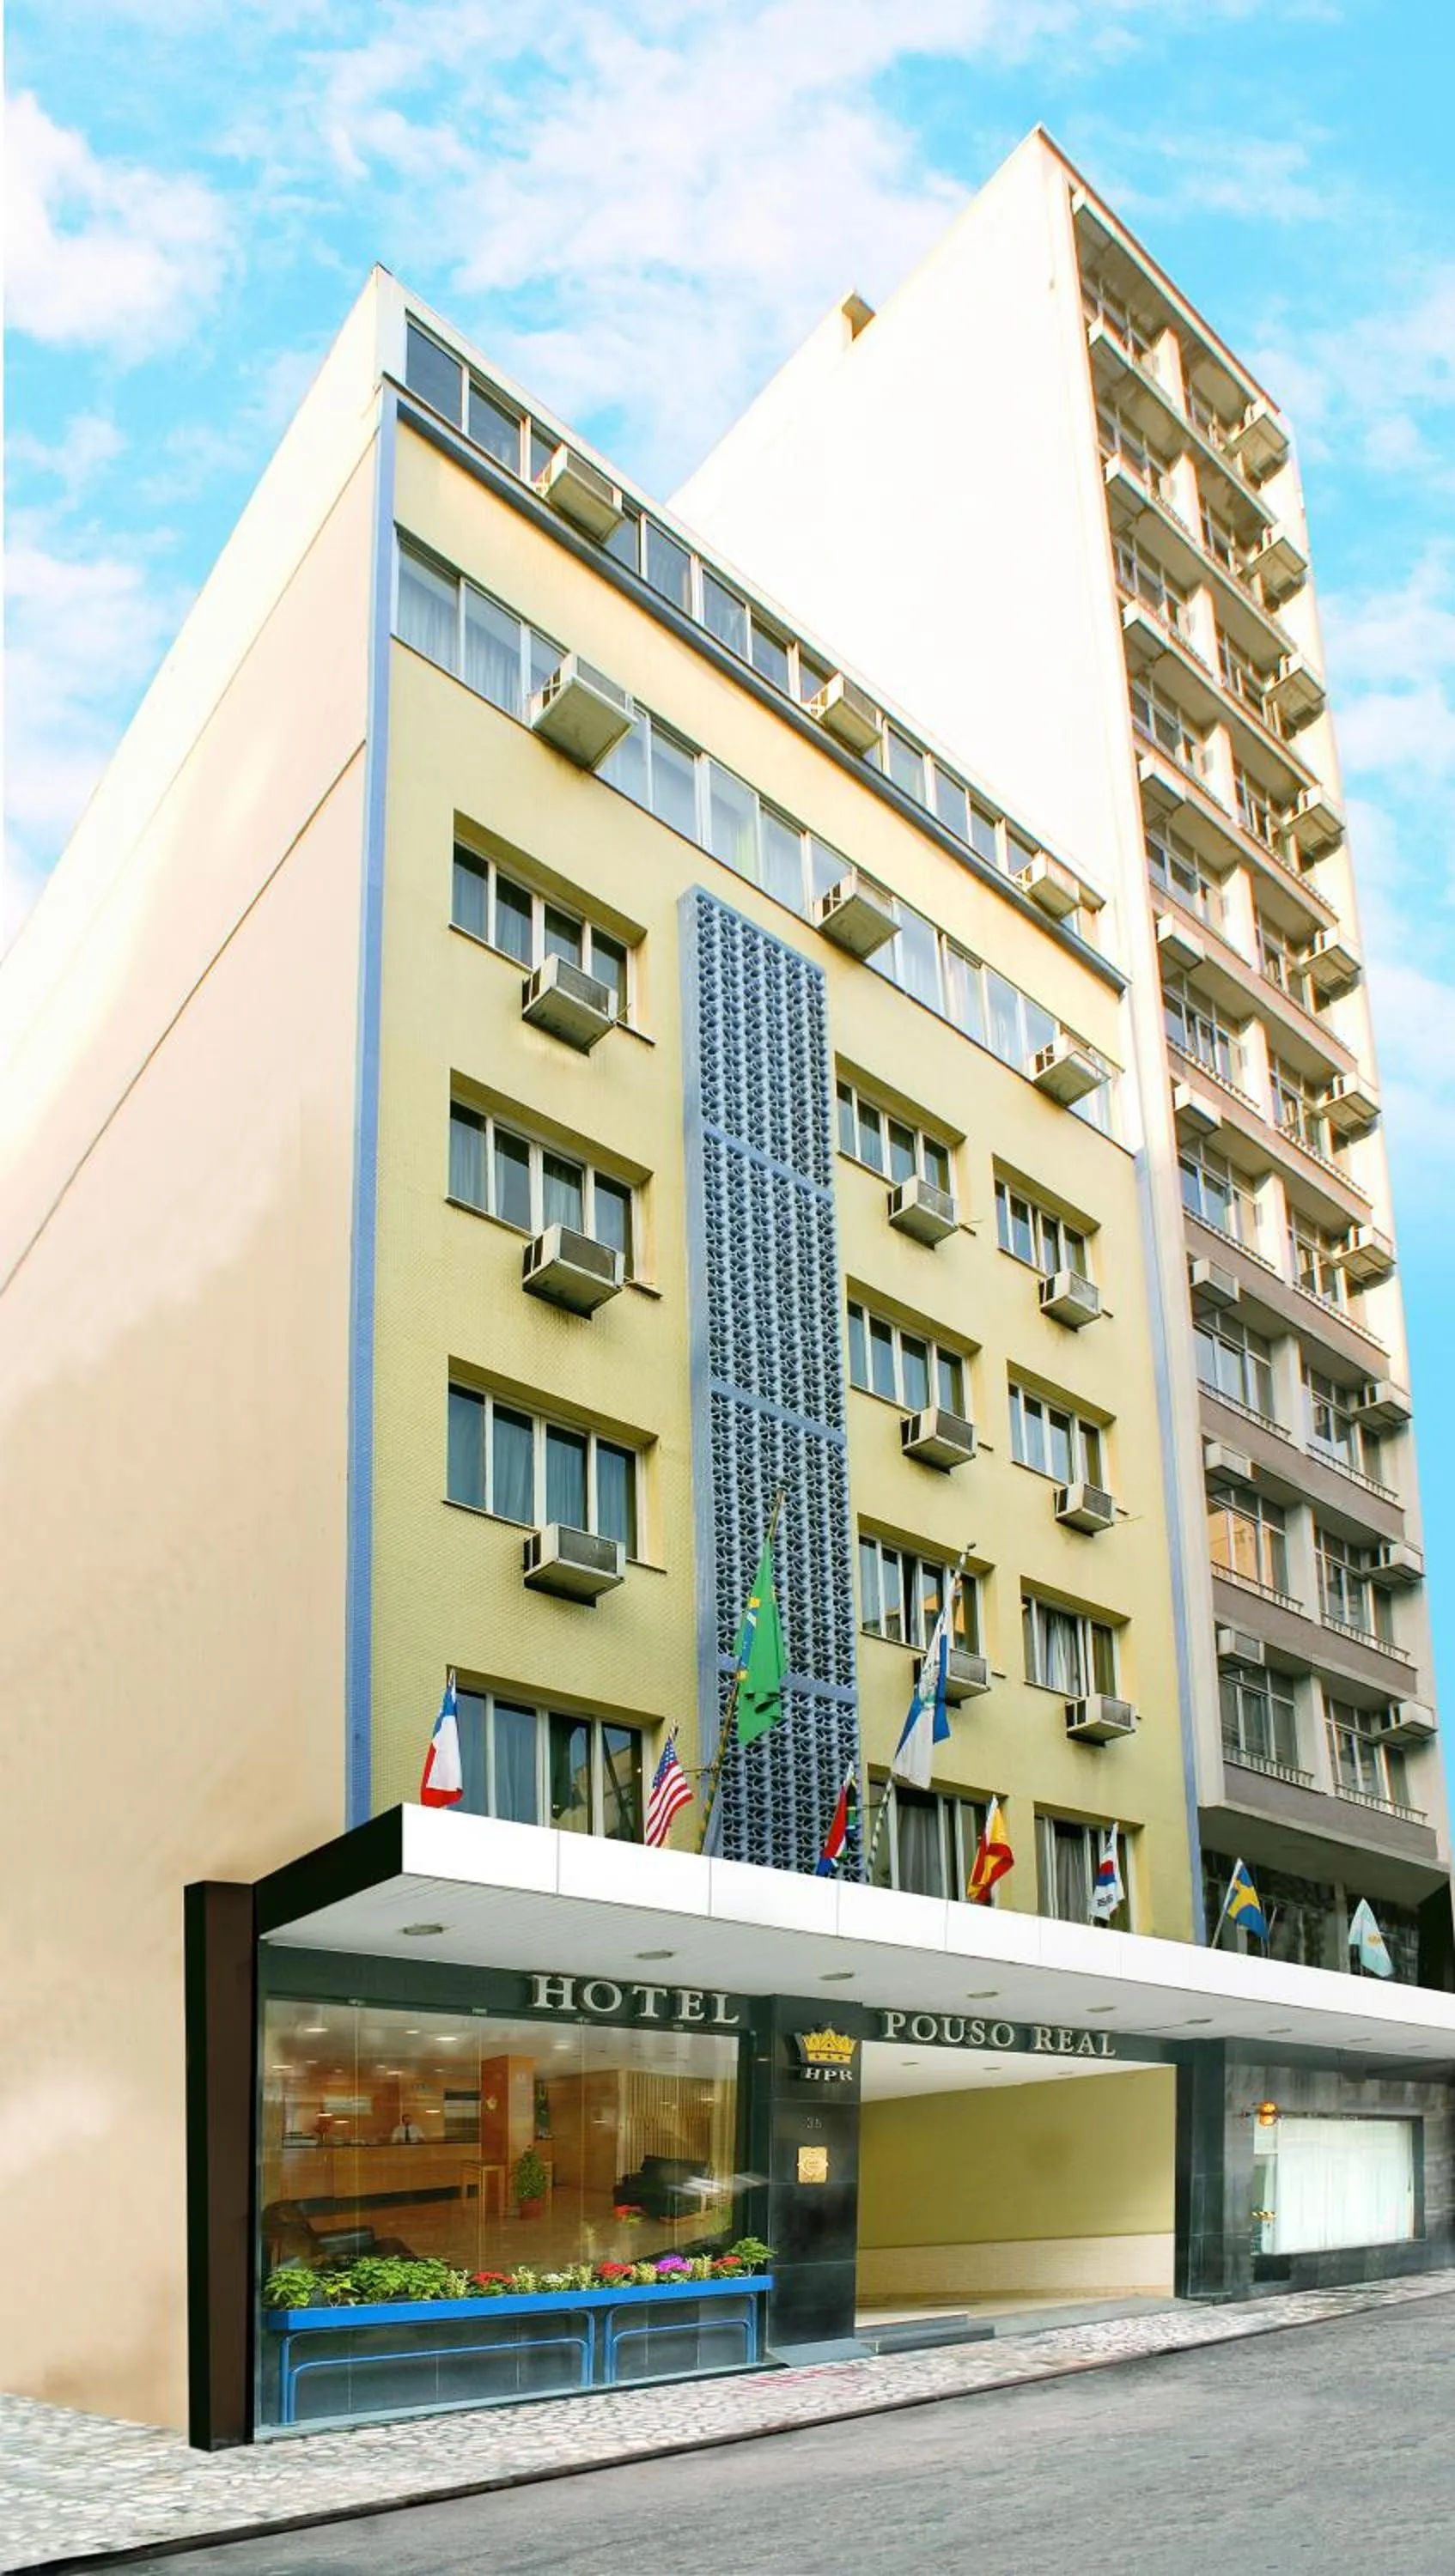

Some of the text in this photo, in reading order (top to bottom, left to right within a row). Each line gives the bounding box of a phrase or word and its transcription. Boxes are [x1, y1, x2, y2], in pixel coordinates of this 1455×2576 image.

[531, 1975, 740, 2024] HOTEL
[884, 2011, 1116, 2057] POUSO REAL
[805, 2067, 853, 2081] HPR
